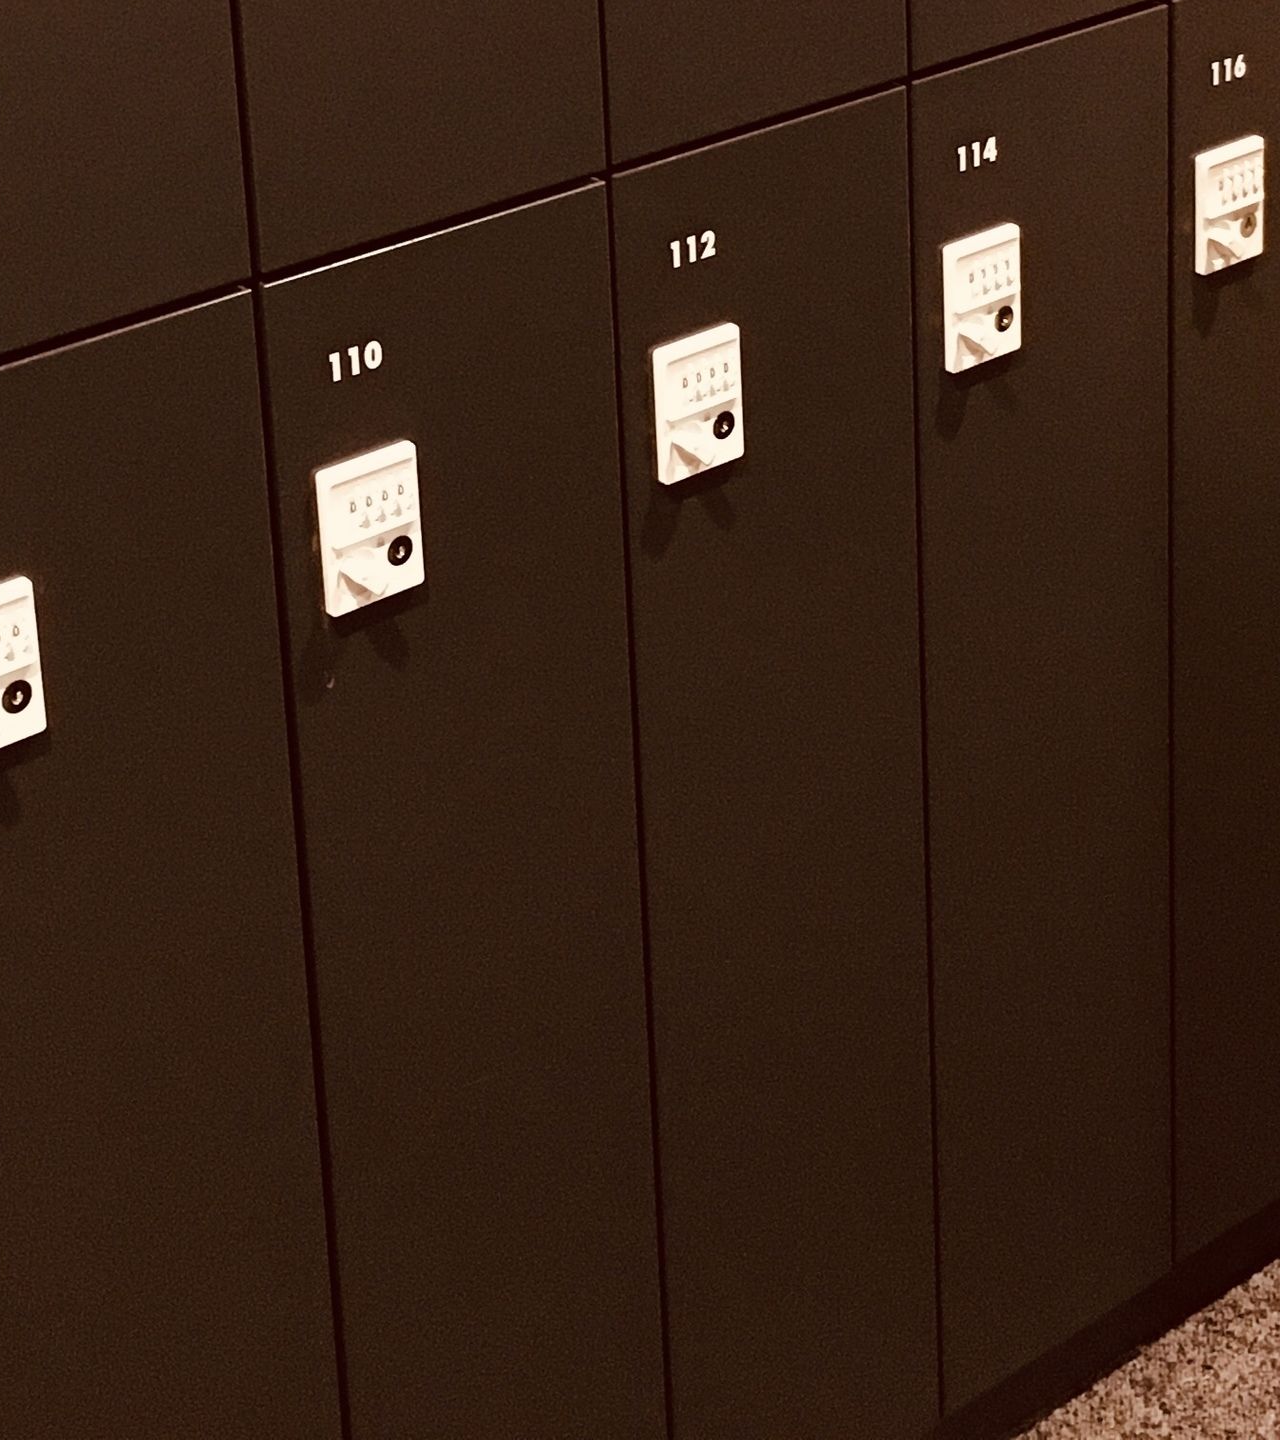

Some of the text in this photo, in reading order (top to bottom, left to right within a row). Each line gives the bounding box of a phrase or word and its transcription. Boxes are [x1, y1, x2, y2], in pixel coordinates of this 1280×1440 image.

[1212, 54, 1246, 85] 116
[958, 137, 997, 171] 114
[671, 231, 715, 268] 112
[329, 341, 382, 381] 110
